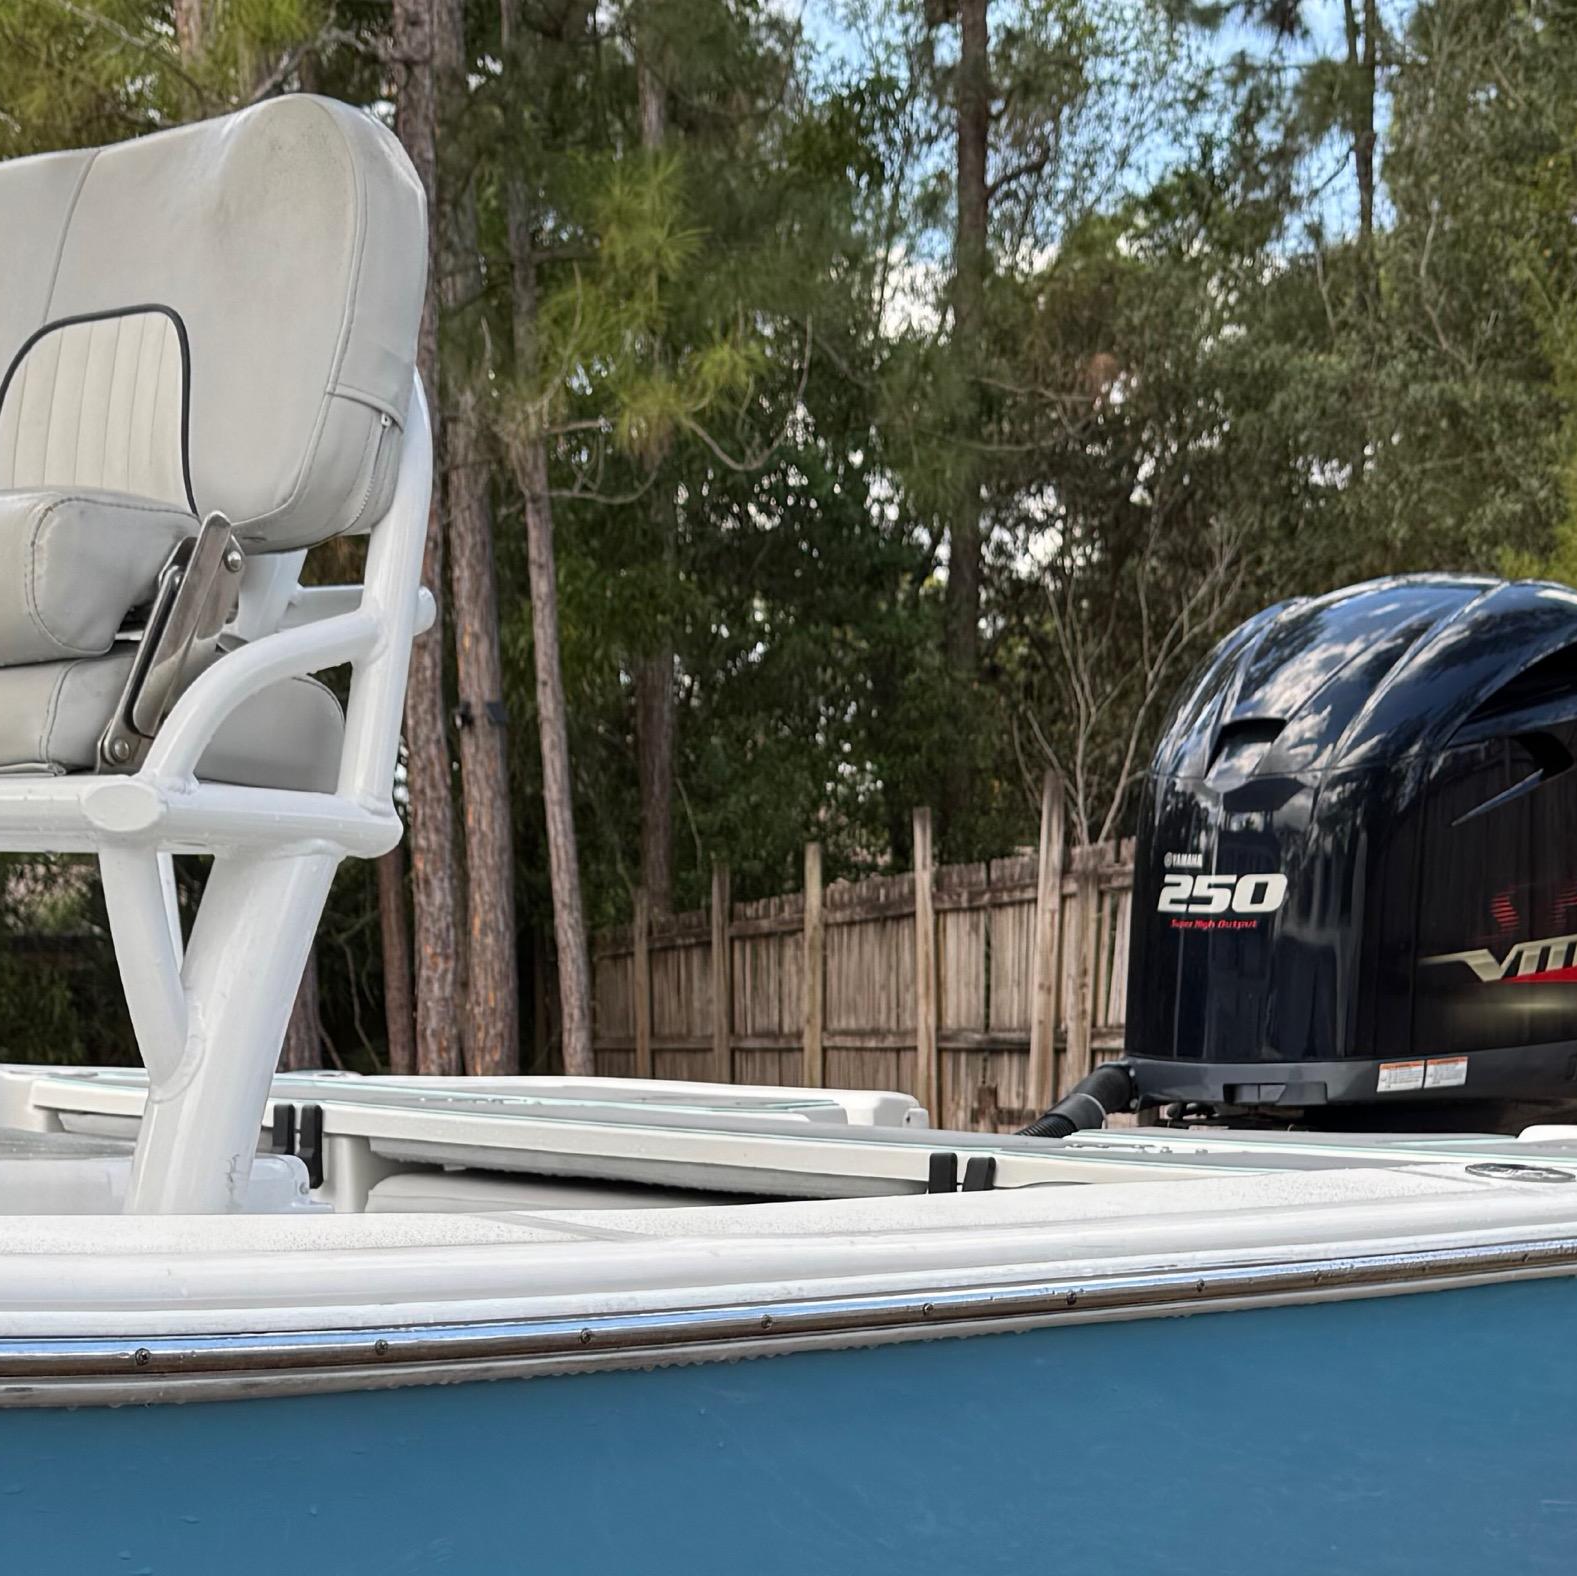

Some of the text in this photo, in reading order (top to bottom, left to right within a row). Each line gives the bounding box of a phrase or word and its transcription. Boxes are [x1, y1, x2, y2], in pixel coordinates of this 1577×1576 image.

[1173, 852, 1203, 868] YAMAHA
[1157, 873, 1288, 913] 250
[1170, 919, 1257, 930] Super High Output
